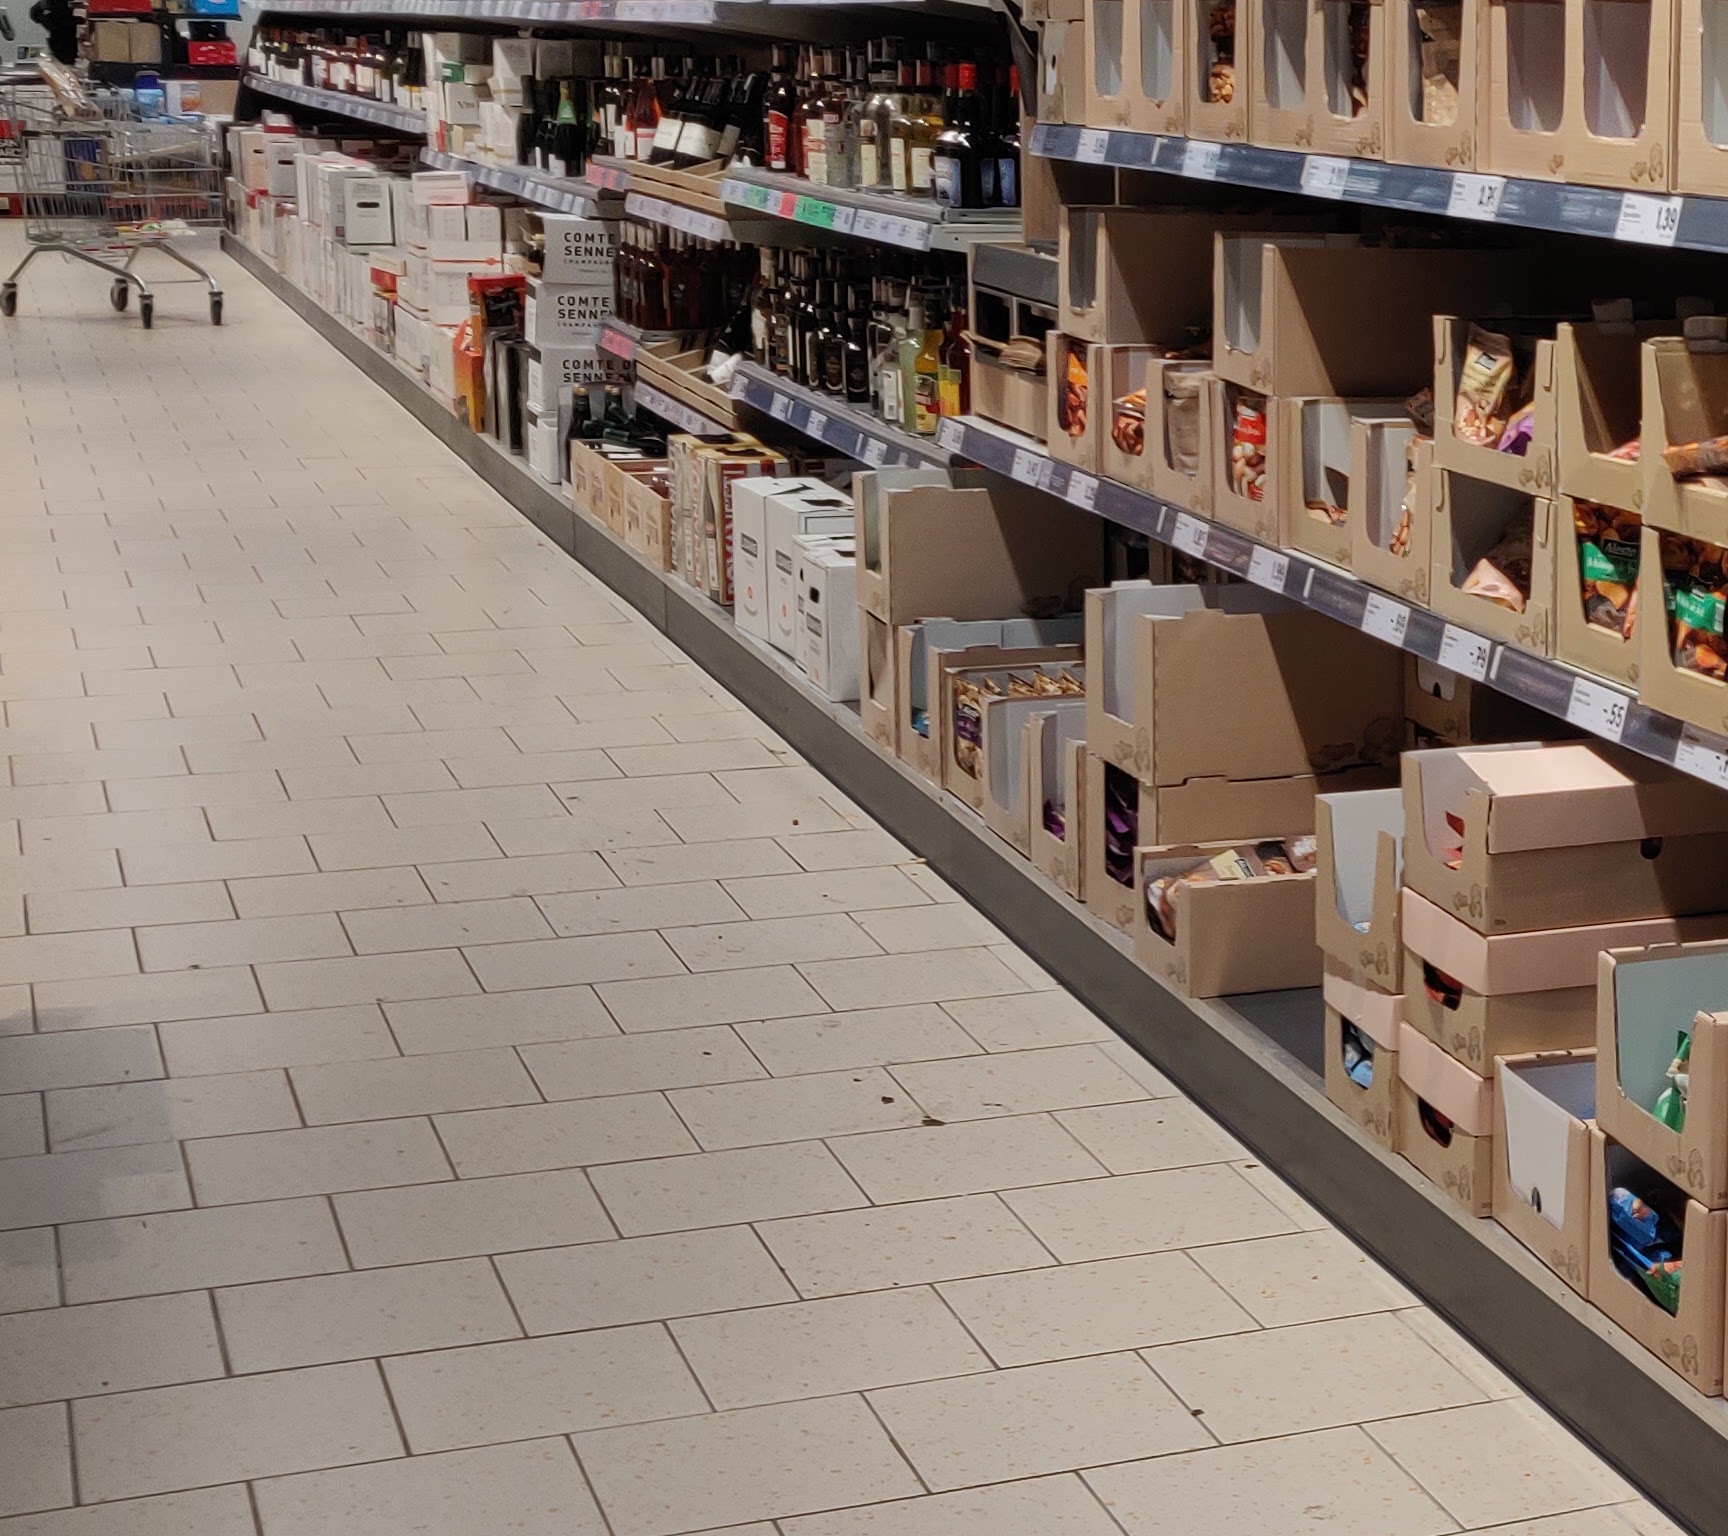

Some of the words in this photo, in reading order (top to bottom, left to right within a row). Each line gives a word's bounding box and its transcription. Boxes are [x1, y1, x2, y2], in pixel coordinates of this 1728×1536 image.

[564, 232, 616, 245] COMTE
[564, 246, 616, 258] SENNE
[557, 295, 611, 308] COMTE
[562, 359, 615, 370] COMTE
